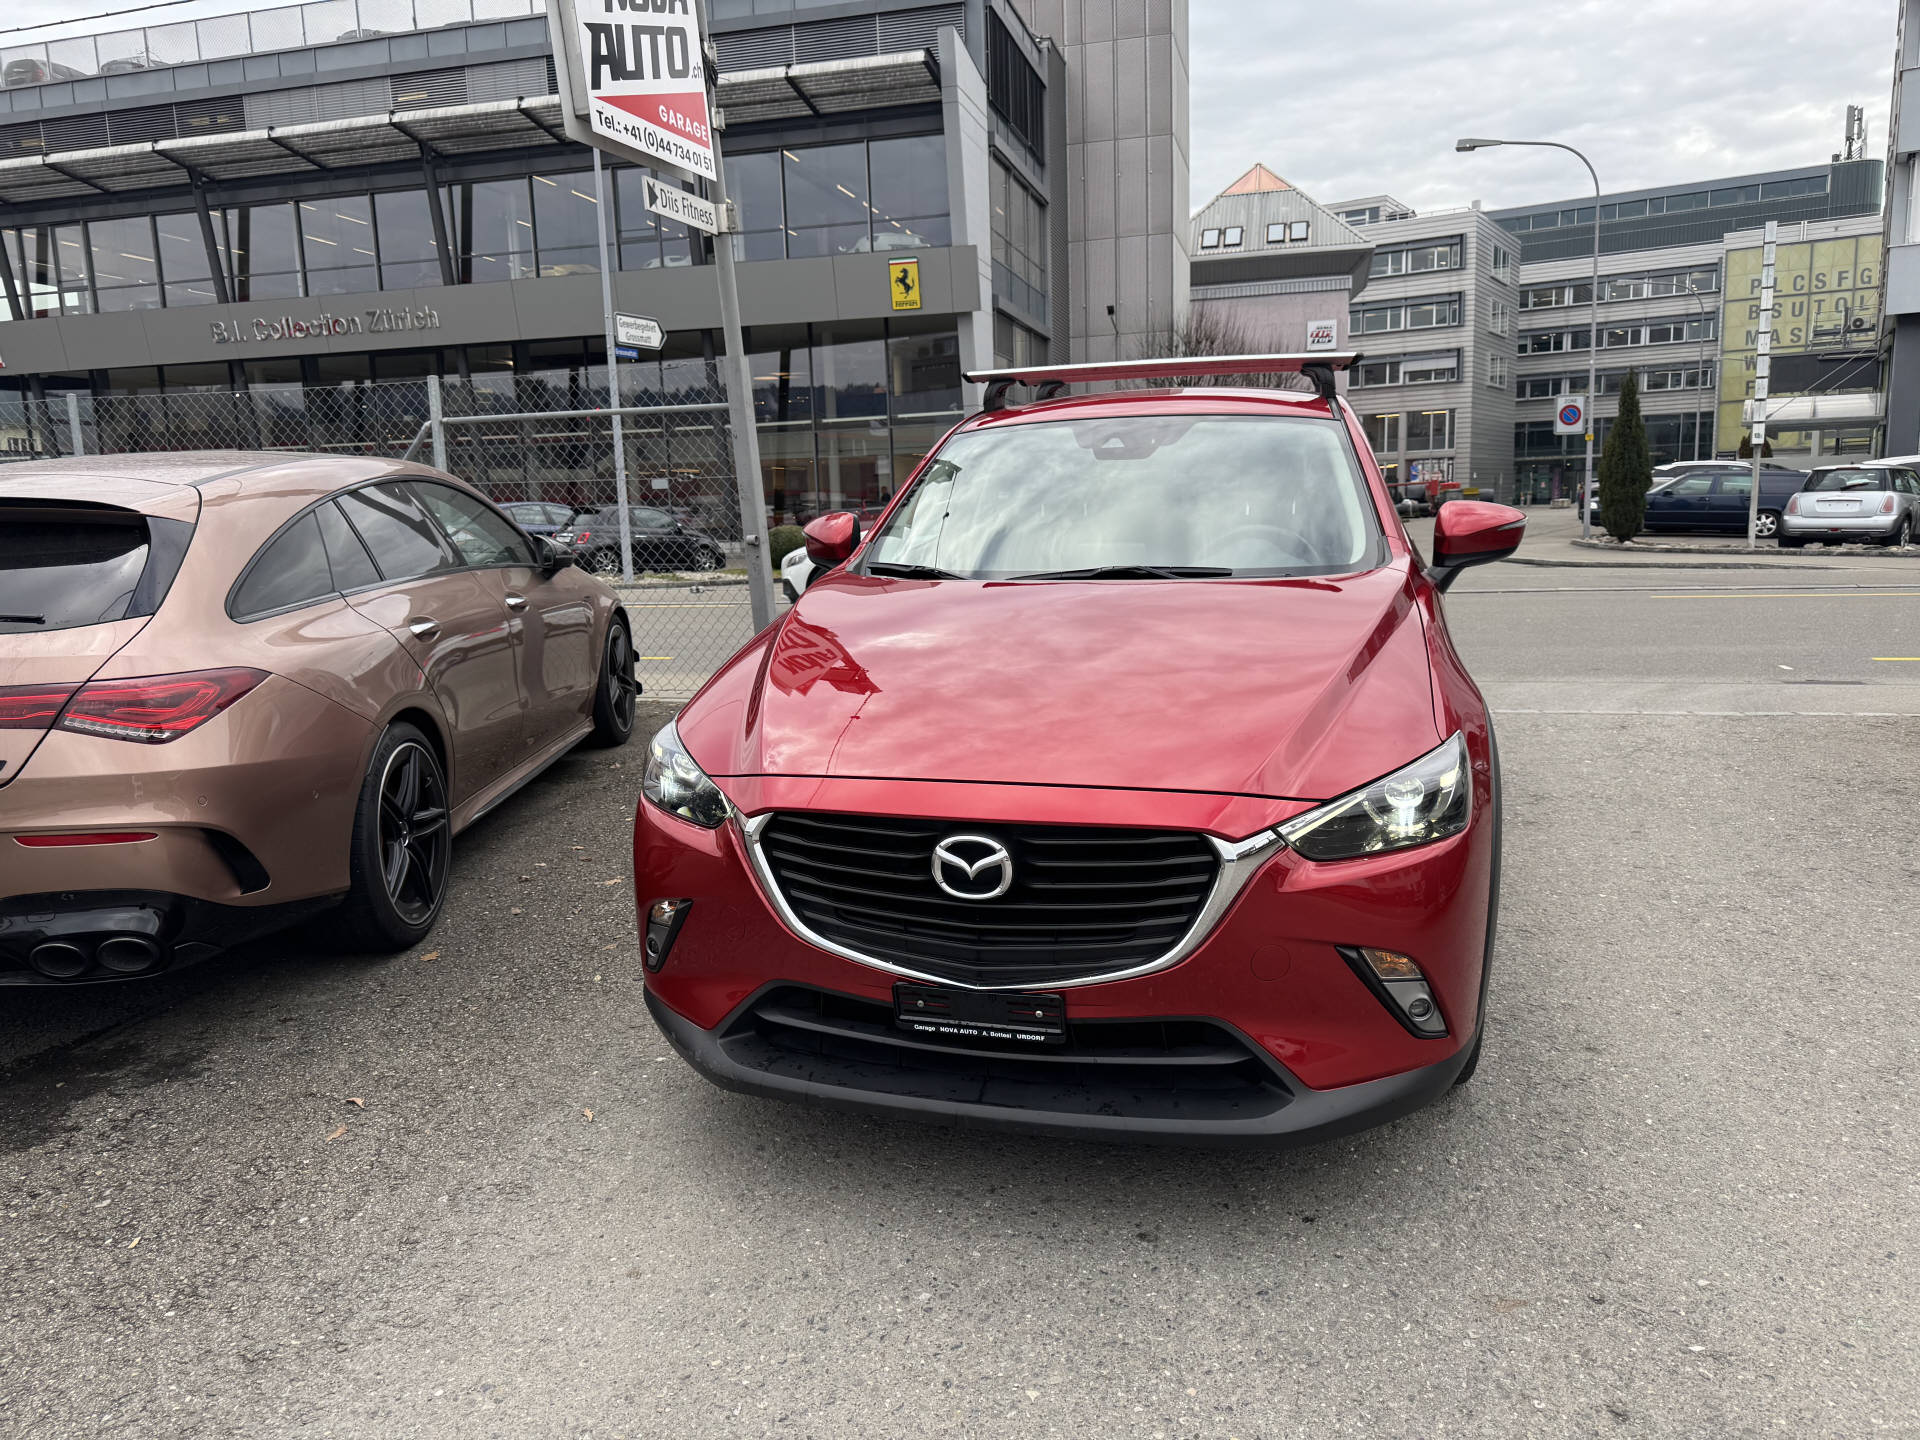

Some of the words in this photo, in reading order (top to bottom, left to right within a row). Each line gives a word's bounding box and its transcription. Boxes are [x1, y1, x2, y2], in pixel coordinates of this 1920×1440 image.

[596, 109, 621, 134] Tel.:
[623, 125, 643, 142] +41
[658, 104, 709, 142] GARAGE
[660, 188, 680, 214] Diis
[681, 197, 714, 227] Fitness
[252, 313, 363, 341] Collection
[366, 304, 441, 333] Zürich
[914, 1024, 936, 1032] Garage
[940, 1026, 958, 1034] NOVA
